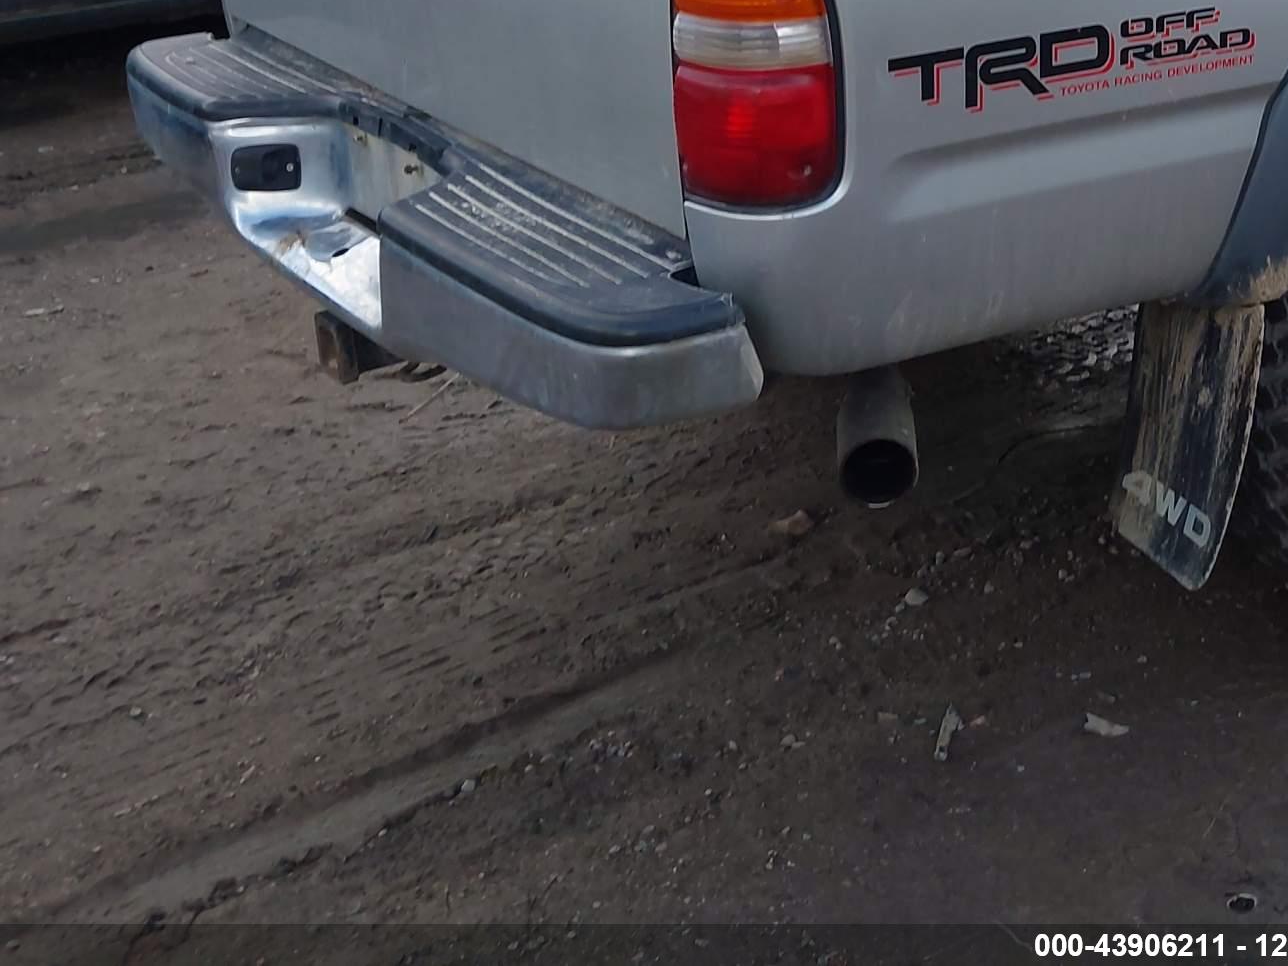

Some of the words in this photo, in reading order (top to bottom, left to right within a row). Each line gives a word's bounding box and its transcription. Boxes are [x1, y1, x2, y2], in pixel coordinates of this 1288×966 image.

[1120, 6, 1220, 41] OFF
[888, 24, 1114, 114] TRD
[1120, 28, 1255, 69] ROAD
[1061, 79, 1110, 96] TOYOTA
[1115, 70, 1163, 86] RACING
[1167, 55, 1254, 77] DEVELOPMENT
[1122, 470, 1211, 548] 4WD
